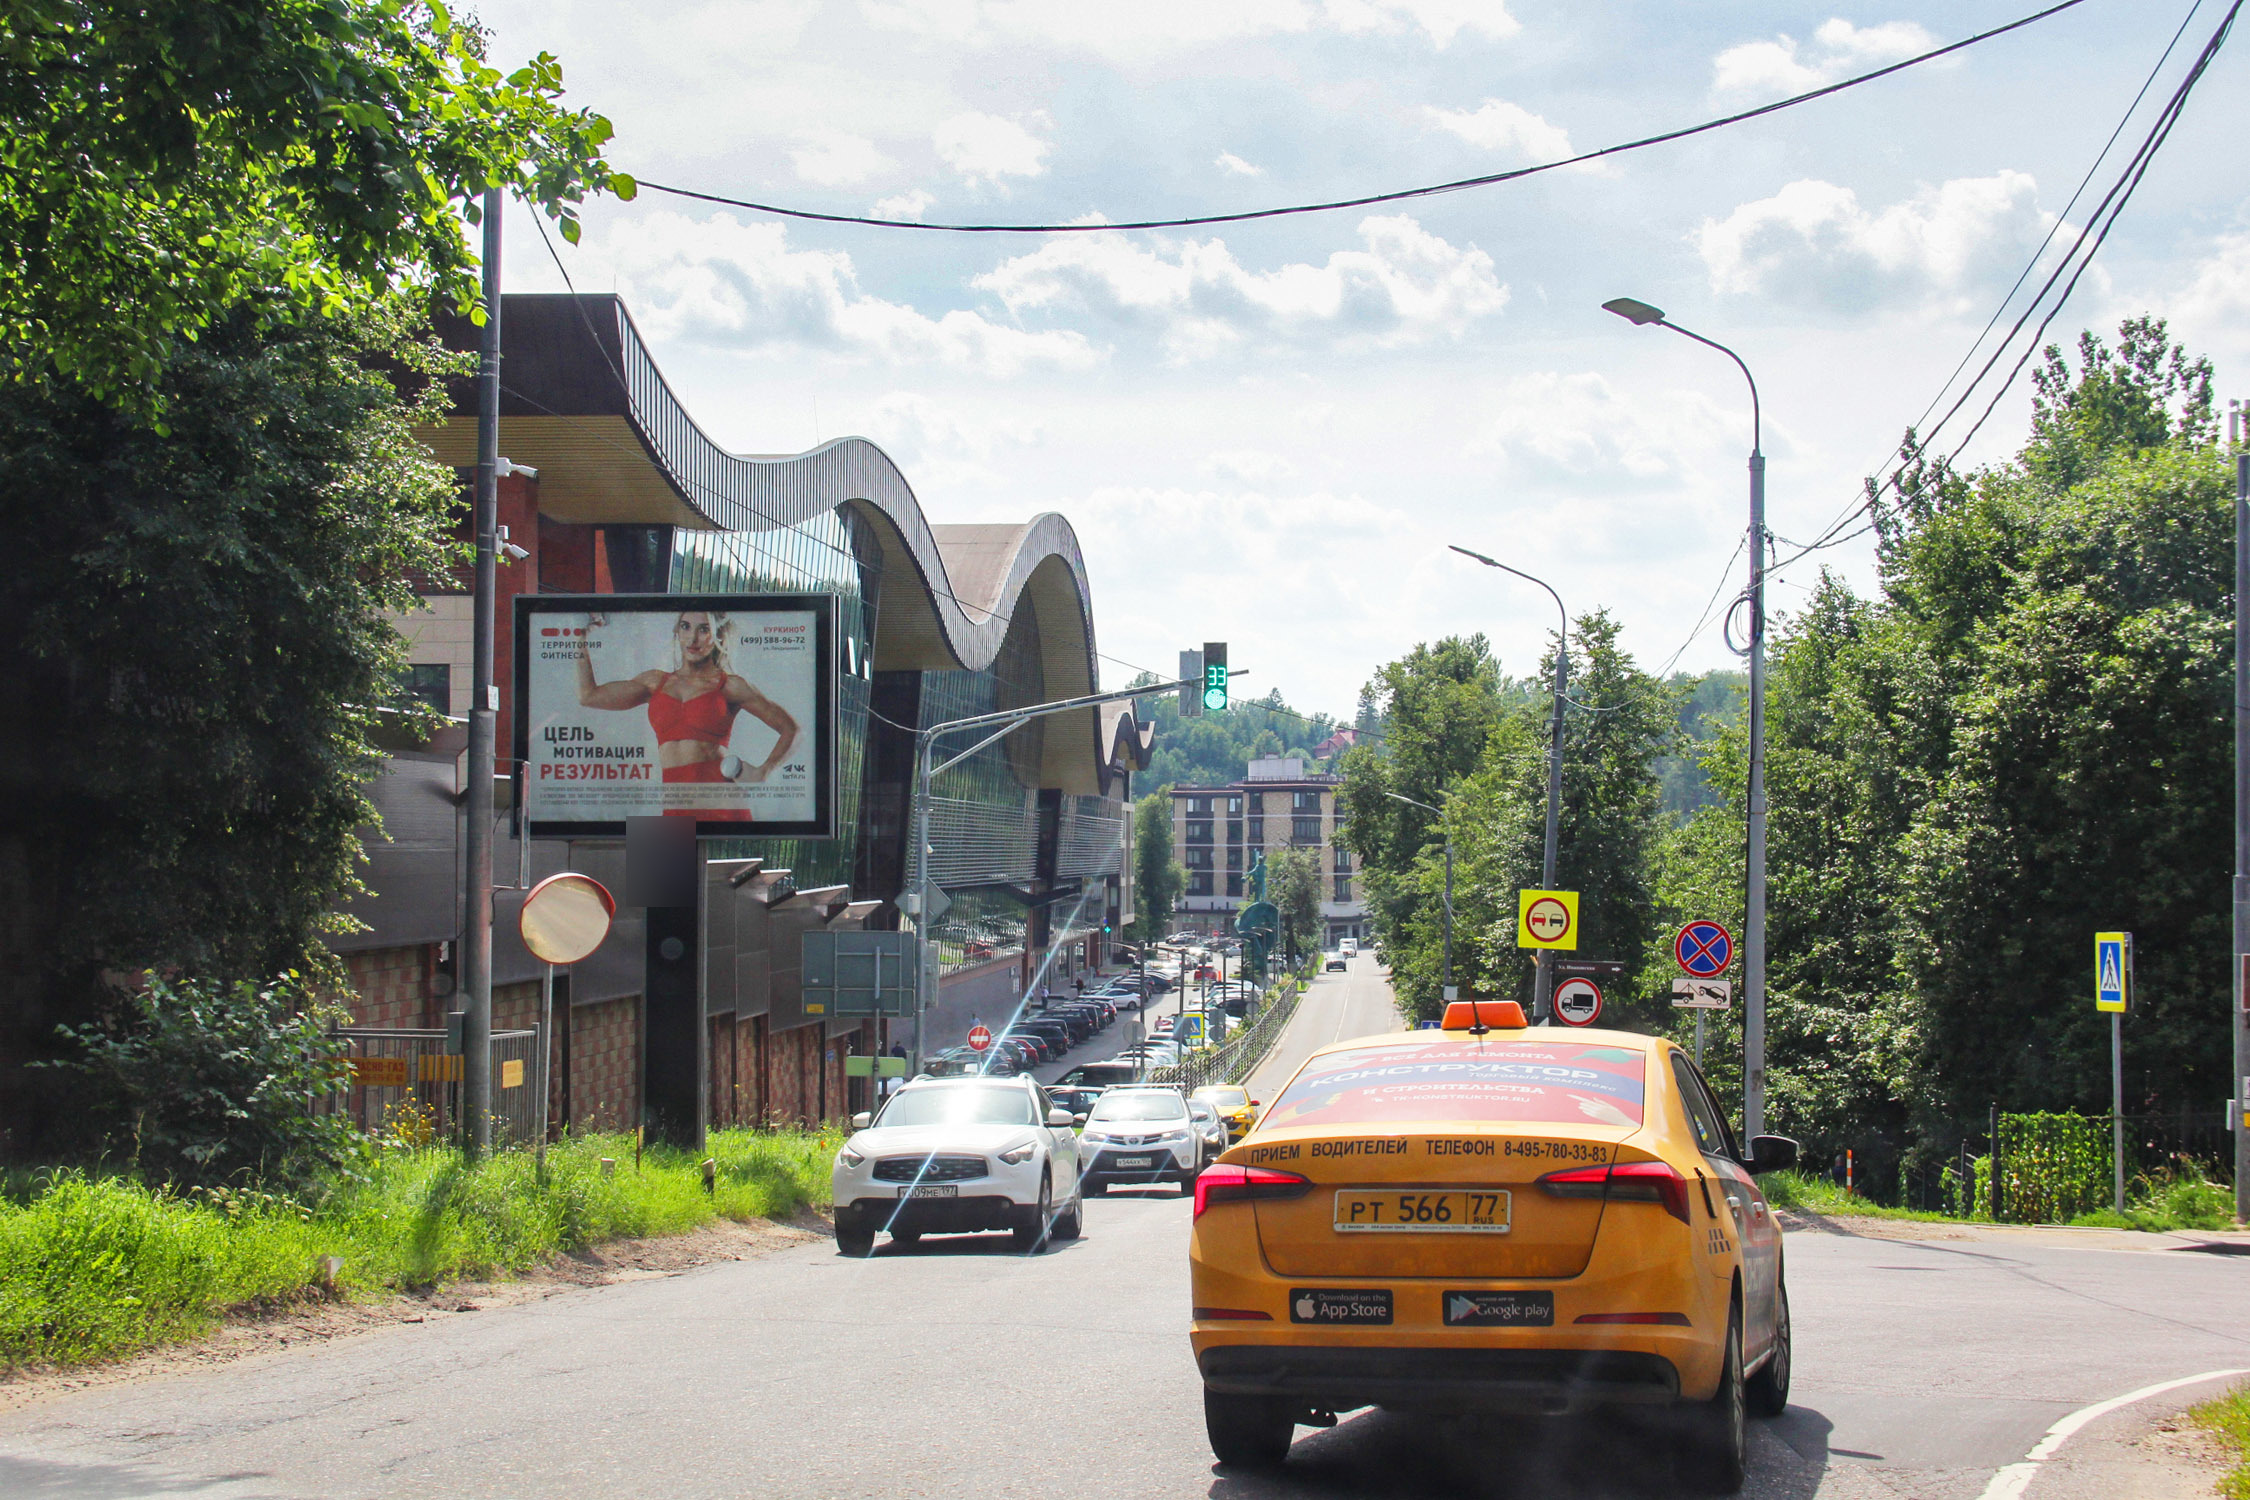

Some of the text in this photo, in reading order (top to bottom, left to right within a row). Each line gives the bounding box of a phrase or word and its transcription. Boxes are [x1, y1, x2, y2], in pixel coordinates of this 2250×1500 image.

[541, 641, 602, 649] ТЕРРИТОРИЯ
[740, 636, 805, 645] (499) 588-96-72
[541, 651, 585, 660] ФИТНЕСА
[1208, 667, 1226, 686] 33
[544, 726, 594, 743] ЦЕЛЬ
[554, 747, 645, 760] МОТИВАЦИЯ
[540, 763, 653, 780] РЕЗУЛЬТАТ
[1380, 1051, 1557, 1062] ВСЕ ДЛЯ РЕМОНТА
[1310, 1063, 1598, 1088] КОНСТРУКТОР
[1362, 1083, 1545, 1095] И СТРОИТЕЛЬСТВА
[1251, 1137, 1607, 1163] ПРИЕМ ВОДИТЕЛЕЙ ТЕЛЕФОН 8-495-780-33-83
[1398, 1195, 1452, 1222] 566
[1470, 1195, 1498, 1215] 77
[1473, 1216, 1494, 1225] RUS
[1318, 1293, 1358, 1301] Download
[1320, 1302, 1387, 1319] App Store
[1476, 1303, 1550, 1320] Google play
